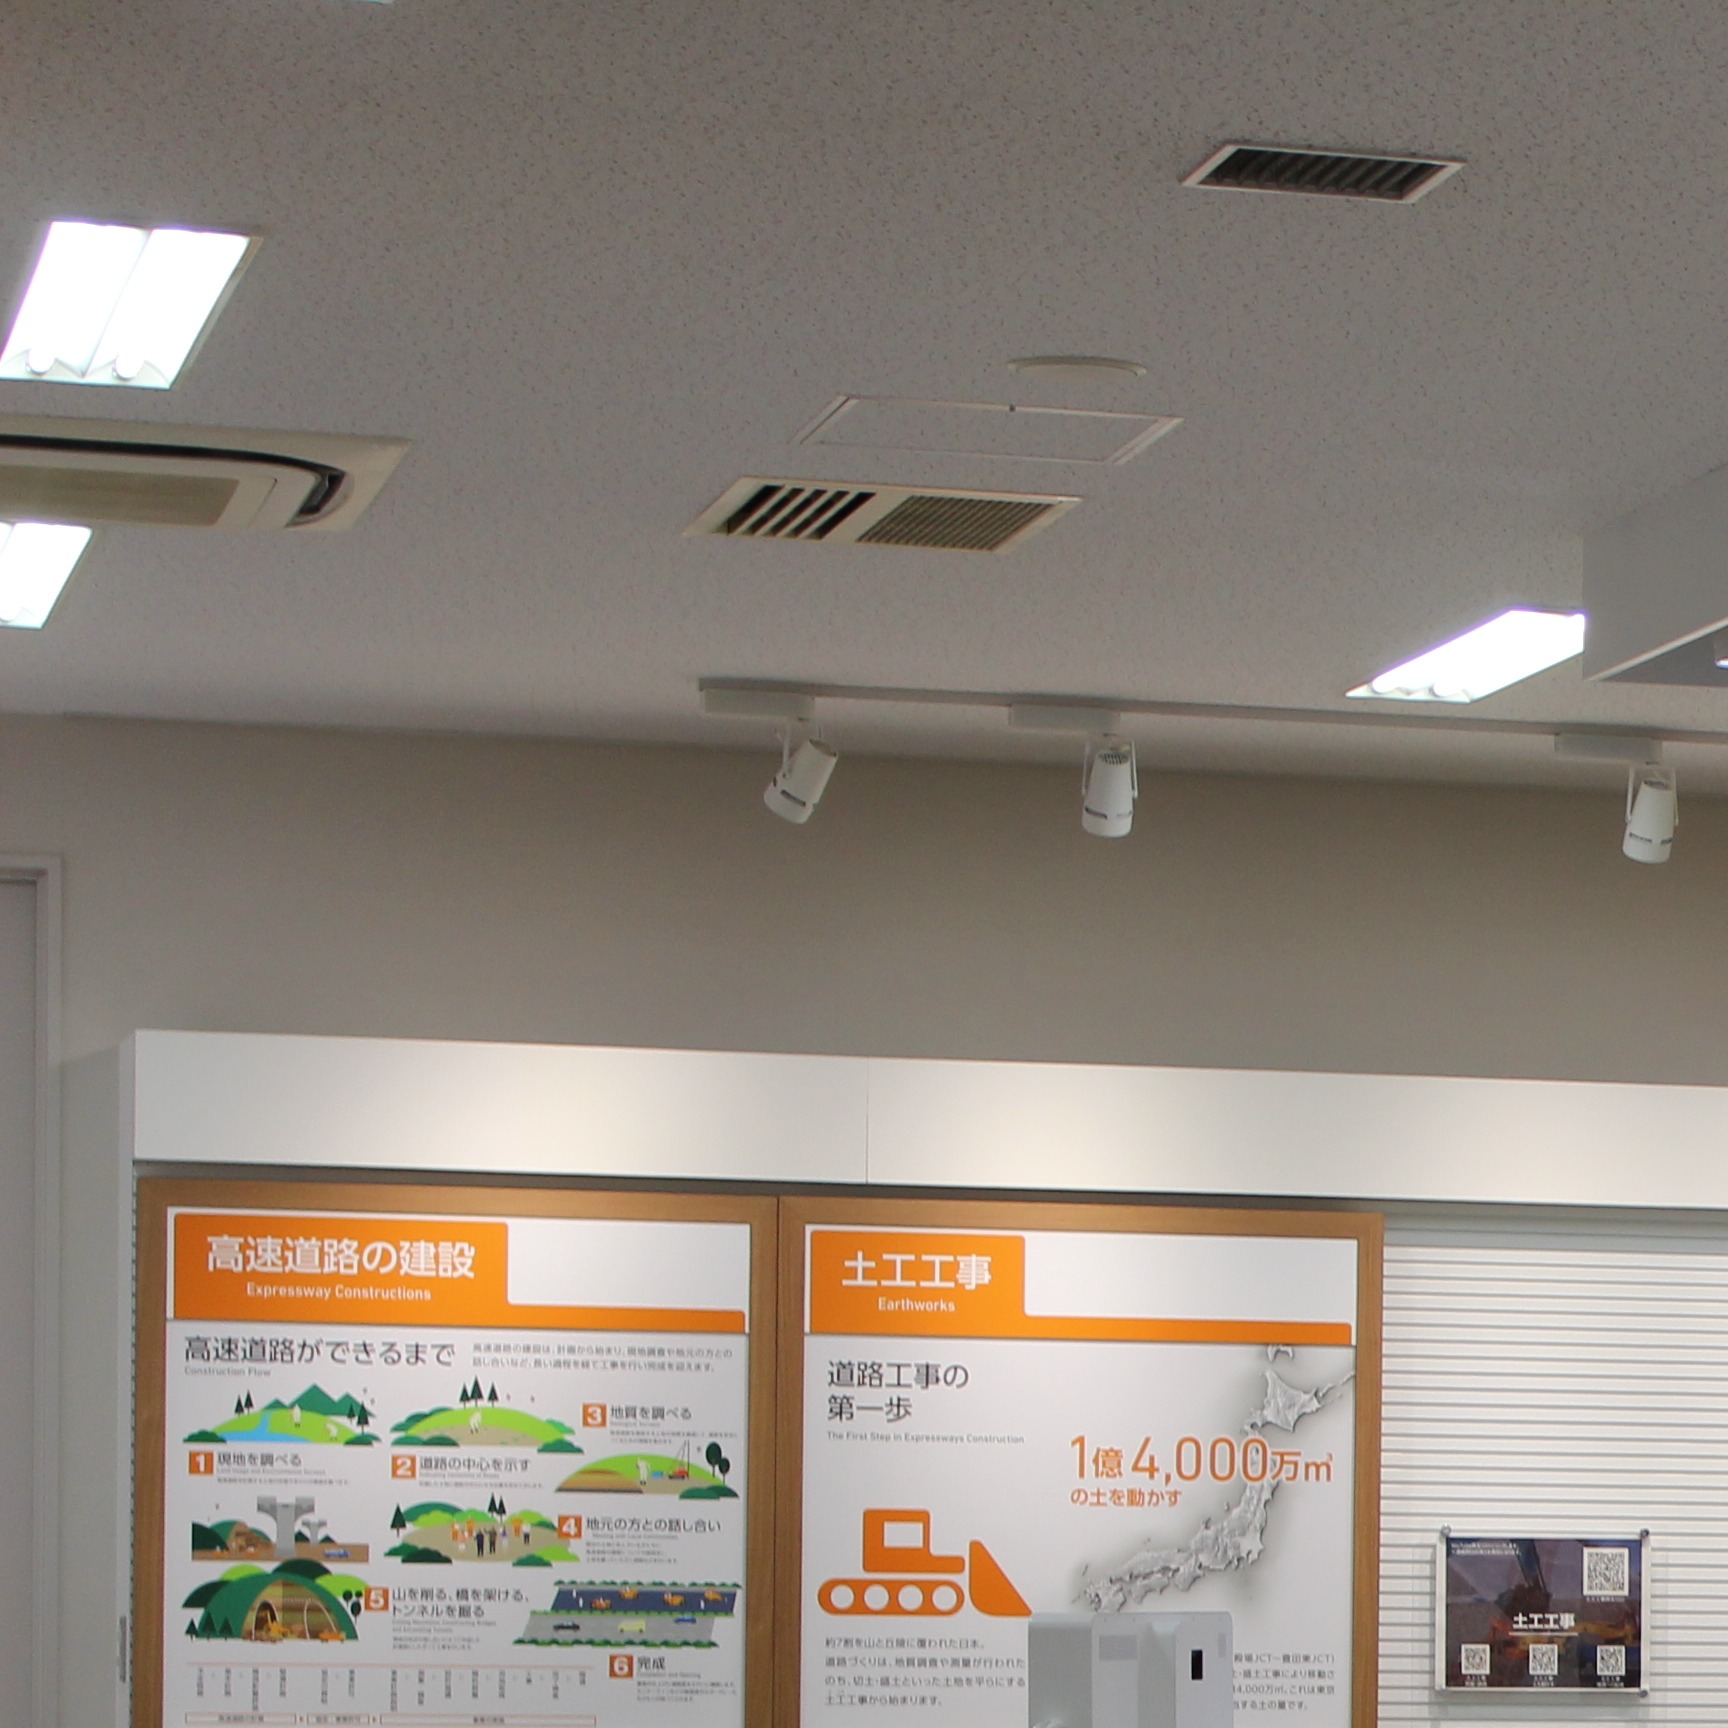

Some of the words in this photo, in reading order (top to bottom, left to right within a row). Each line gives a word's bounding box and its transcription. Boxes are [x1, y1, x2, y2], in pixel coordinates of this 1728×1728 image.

[207, 1234, 475, 1279] 高速道路の建設
[842, 1250, 992, 1290] 土工工事
[246, 1282, 331, 1300] Expressway
[335, 1284, 431, 1301] Constructions
[878, 1297, 956, 1312] Earthworks
[184, 1336, 455, 1366] 高速道路ができるまで
[827, 1359, 970, 1390] 道路工事の
[587, 1407, 602, 1425] 3
[610, 1405, 692, 1421] 地質を調べる
[827, 1394, 913, 1423] 第一歩
[827, 1431, 844, 1440] The
[846, 1431, 867, 1441] First
[870, 1432, 891, 1443] Step
[966, 1434, 1024, 1444] Construction
[196, 1455, 207, 1473] 1
[217, 1453, 302, 1467] 現地を調べる
[396, 1458, 412, 1476] 2
[420, 1457, 530, 1471] 道路の中心を示す
[1071, 1488, 1181, 1507] の土を動かす
[562, 1518, 578, 1538] 4
[586, 1516, 721, 1533] 地元の方との話し合い
[369, 1589, 385, 1609] 5
[392, 1604, 485, 1618] トンネルを掘る
[1512, 1612, 1575, 1630] 土工工事
[613, 1656, 629, 1676] 6
[637, 1656, 665, 1670] 完成
